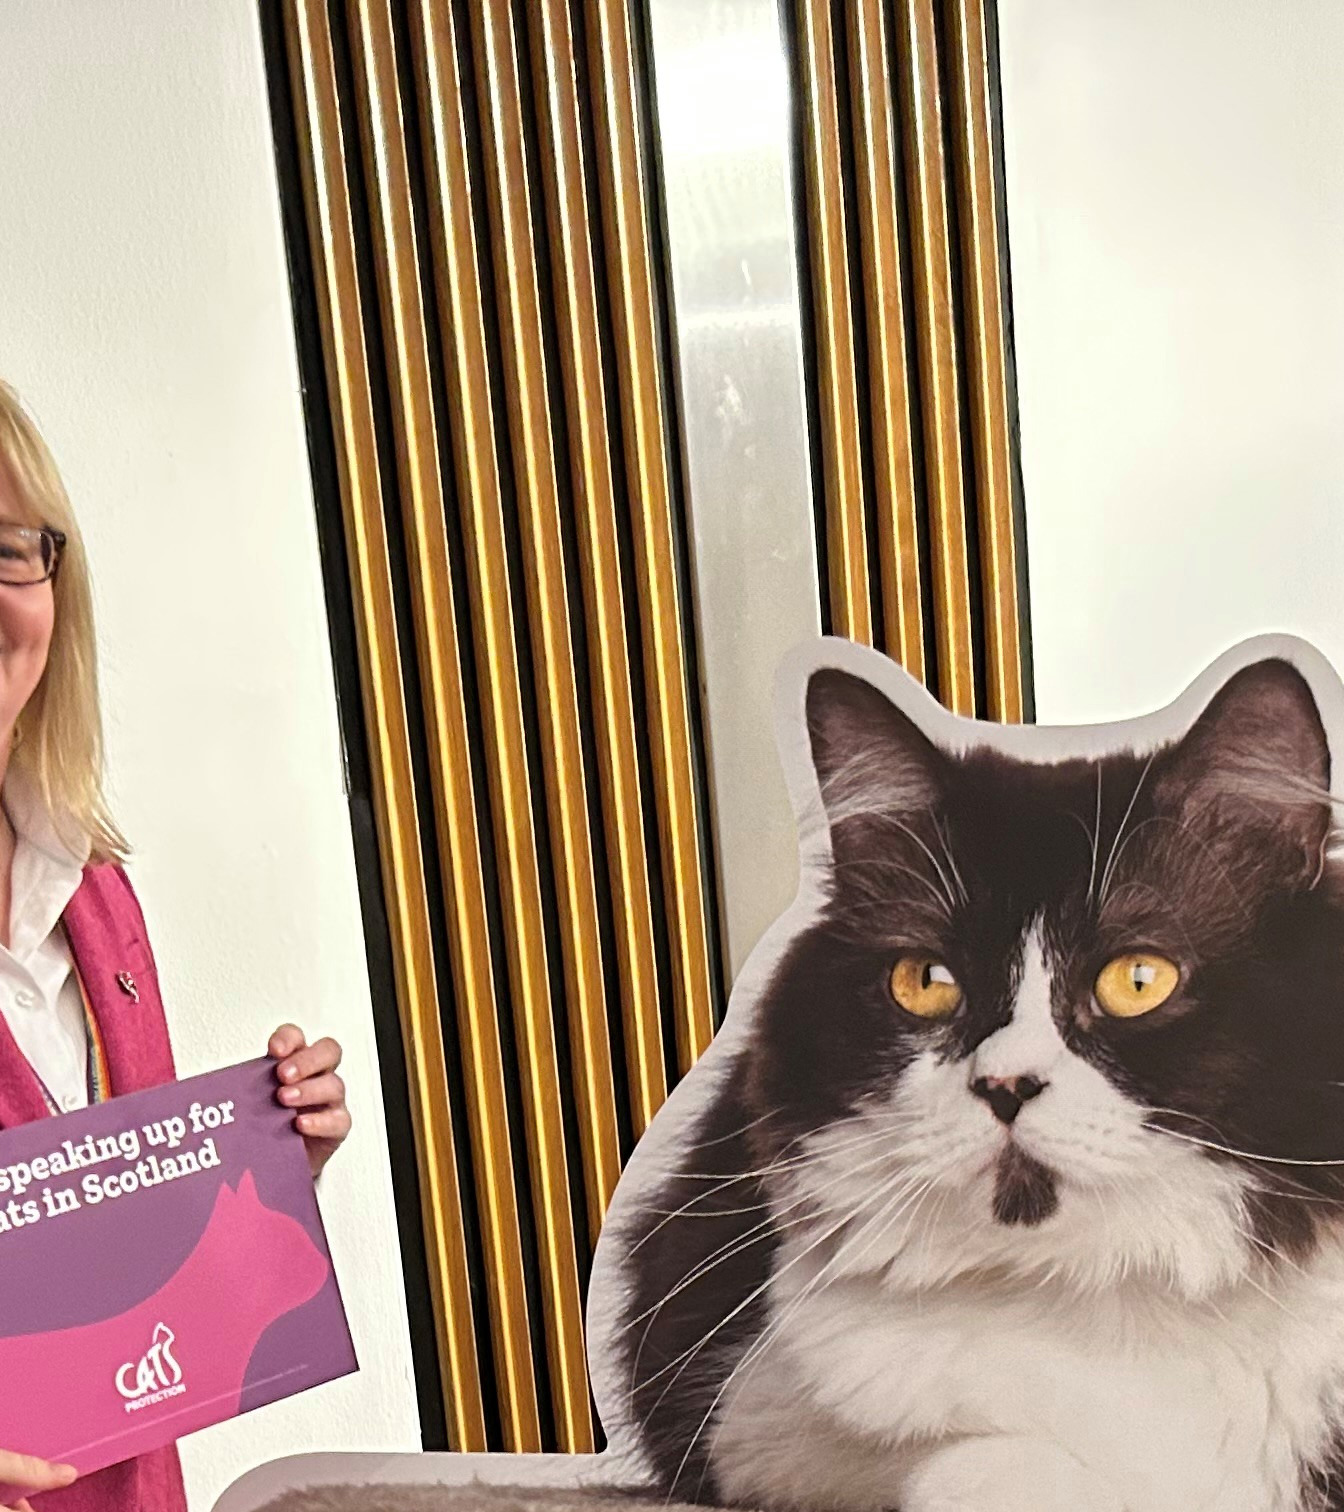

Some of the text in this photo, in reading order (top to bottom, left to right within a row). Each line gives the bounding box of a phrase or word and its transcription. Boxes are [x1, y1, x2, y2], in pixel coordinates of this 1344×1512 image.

[143, 1116, 187, 1149] up
[188, 1098, 236, 1134] for
[42, 1186, 82, 1218] in
[84, 1138, 222, 1204] Scotland
[115, 1333, 183, 1399] CATS
[124, 1383, 187, 1413] PROTECTION
